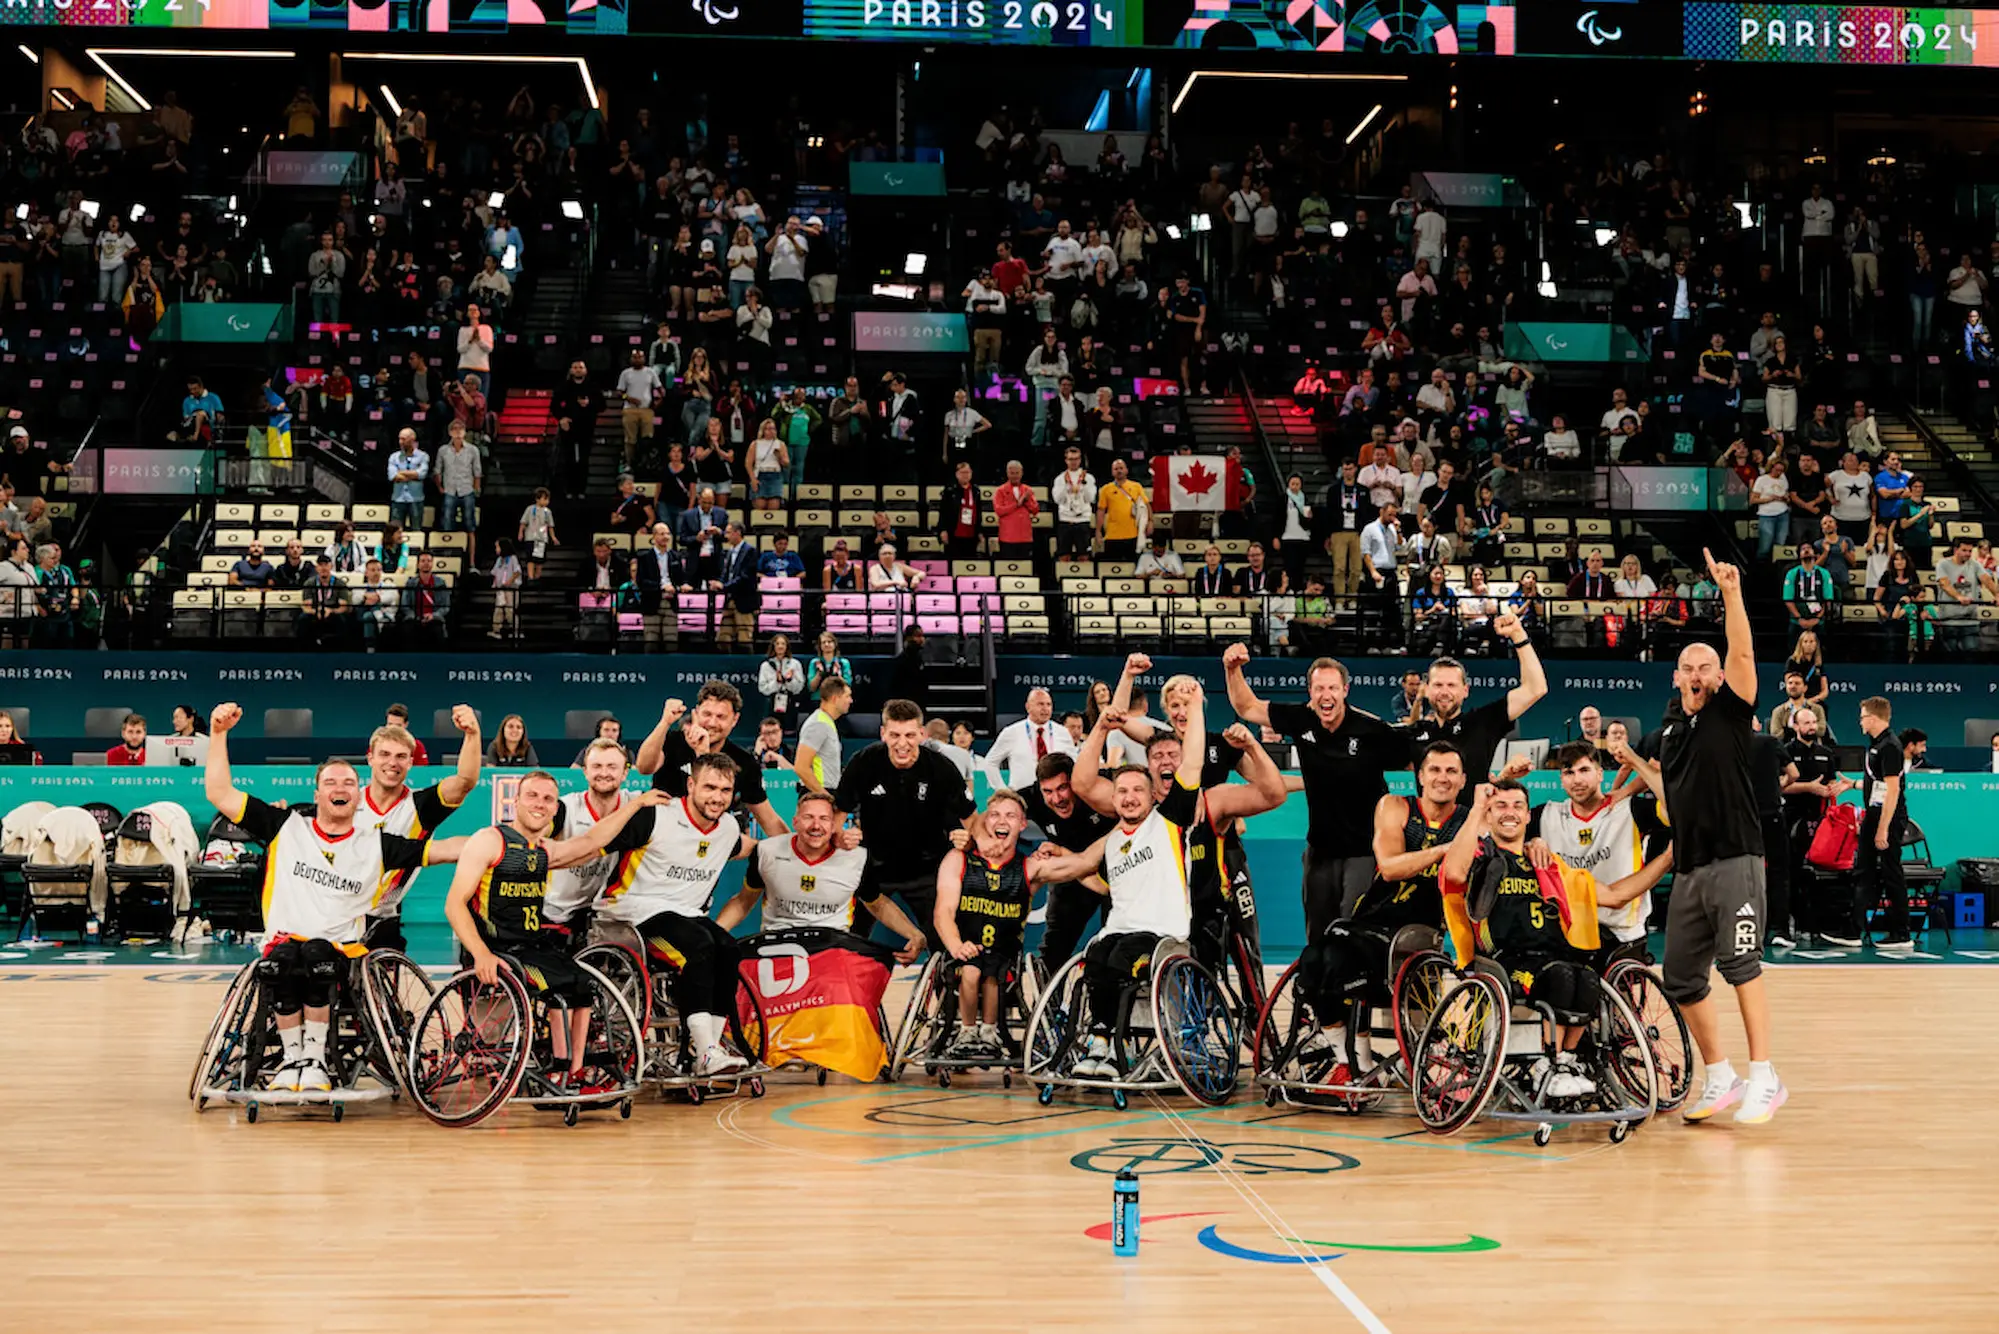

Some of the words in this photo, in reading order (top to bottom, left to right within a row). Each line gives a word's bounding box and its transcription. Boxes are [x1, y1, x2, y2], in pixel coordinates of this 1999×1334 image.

[863, 0, 985, 27] PARIS
[1003, 0, 1113, 30] 2024
[1740, 18, 1856, 48] PARIS
[1874, 22, 1977, 51] 2024
[862, 325, 907, 338] PARIS
[912, 326, 954, 339] 2024
[108, 464, 160, 478] PARIS
[1655, 482, 1700, 496] 2024
[0, 668, 29, 679] ARIS
[35, 668, 72, 680] 2024
[103, 669, 145, 680] PARIS
[150, 669, 188, 681] 2024
[219, 669, 260, 680] PARIS
[265, 670, 302, 681] 2024
[333, 670, 375, 681] PARIS
[380, 670, 417, 681] 2024
[449, 671, 490, 681] PARIS
[494, 671, 532, 682] 2024
[563, 672, 604, 683] PARIS
[609, 672, 646, 683] 2024
[1014, 675, 1054, 685] PARIS
[1058, 675, 1095, 685] 2024
[1134, 676, 1164, 686] ARIS
[1279, 677, 1307, 687] 202
[1500, 678, 1518, 689] 20
[1564, 679, 1603, 689] PARIS
[1608, 679, 1643, 690] 2024
[1829, 682, 1857, 693] 024
[1885, 682, 1923, 693] PARIS
[1927, 682, 1962, 693] 2024
[31, 777, 62, 785] PARIS
[66, 777, 94, 786] 2024
[111, 777, 143, 785] PARIS
[147, 777, 174, 786] 2024
[271, 777, 302, 786] PARIS
[1907, 783, 1937, 791] PARIS
[1939, 783, 1967, 791] 2024
[293, 861, 362, 894] DEUTSCHLAND
[1236, 886, 1255, 919] GER
[523, 905, 540, 931] 13
[1530, 902, 1544, 929] 5
[982, 924, 996, 947] 8
